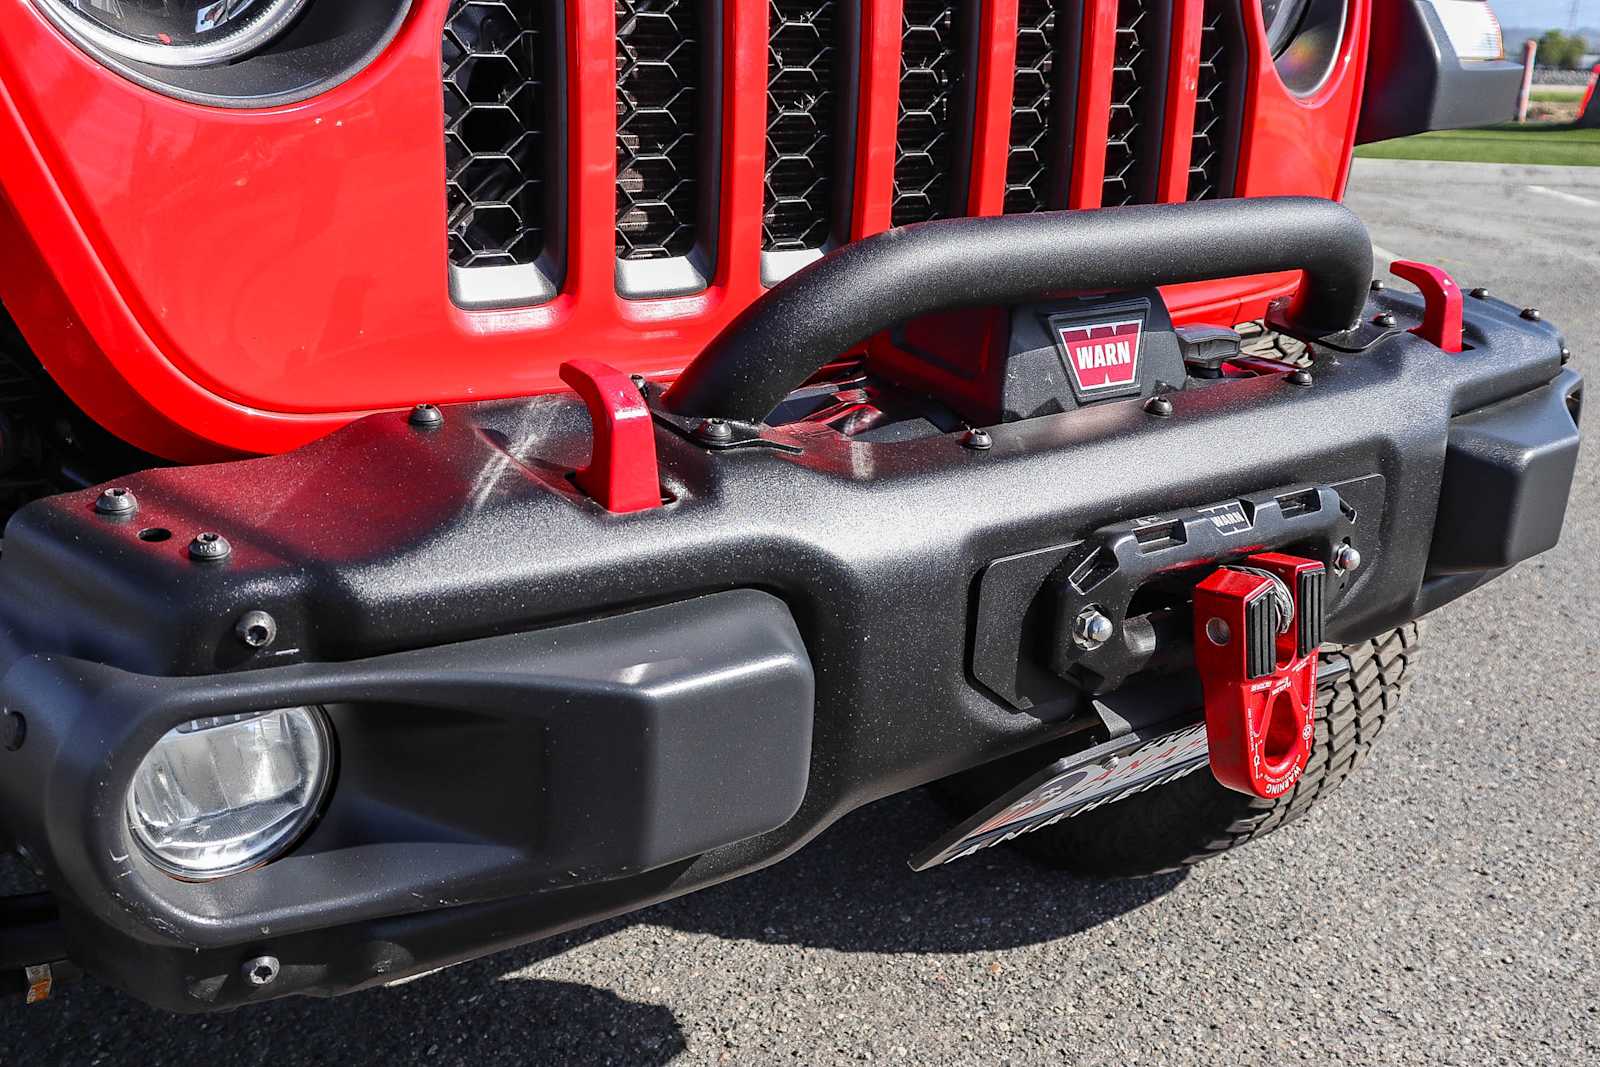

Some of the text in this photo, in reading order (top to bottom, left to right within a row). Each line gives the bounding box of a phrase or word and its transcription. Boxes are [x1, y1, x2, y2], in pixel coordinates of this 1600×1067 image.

[1076, 341, 1130, 369] WARN
[1210, 511, 1245, 528] WARN
[1265, 766, 1302, 795] WARNING
